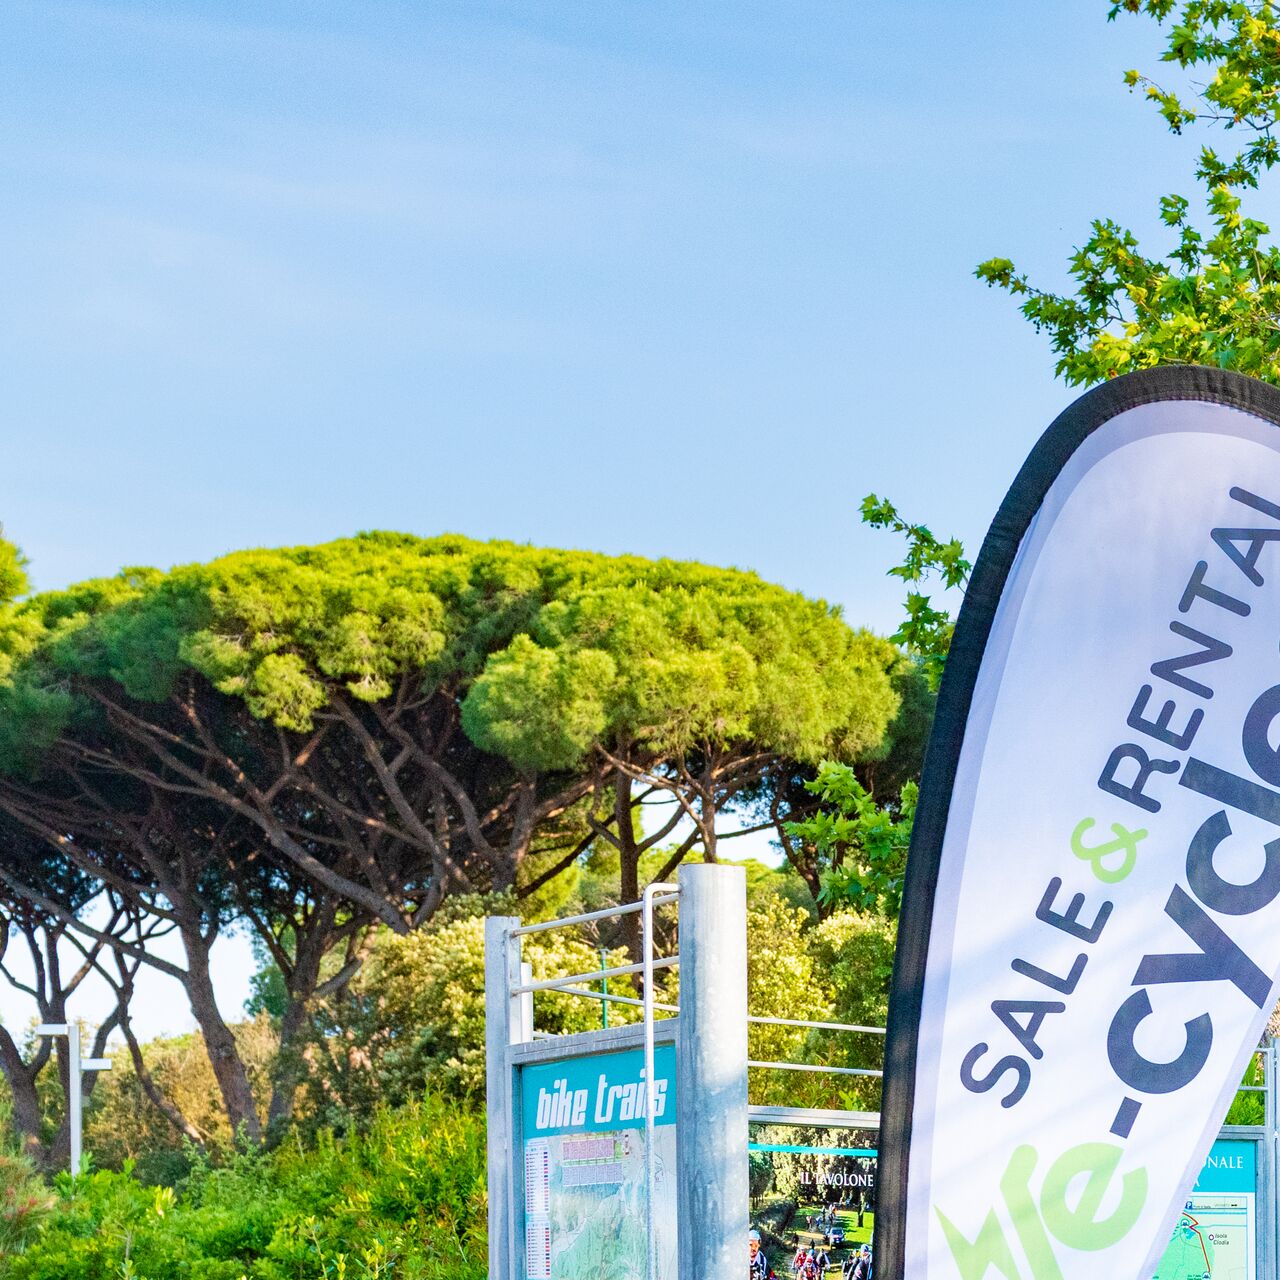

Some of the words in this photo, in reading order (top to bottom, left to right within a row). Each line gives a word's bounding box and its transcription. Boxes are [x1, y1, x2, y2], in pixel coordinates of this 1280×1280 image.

[959, 875, 1114, 1109] SALE
[1070, 816, 1148, 884] &
[535, 1078, 589, 1130] bike
[594, 1067, 669, 1124] trais
[800, 1171, 813, 1185] IL
[814, 1172, 875, 1188] TAVOLONE
